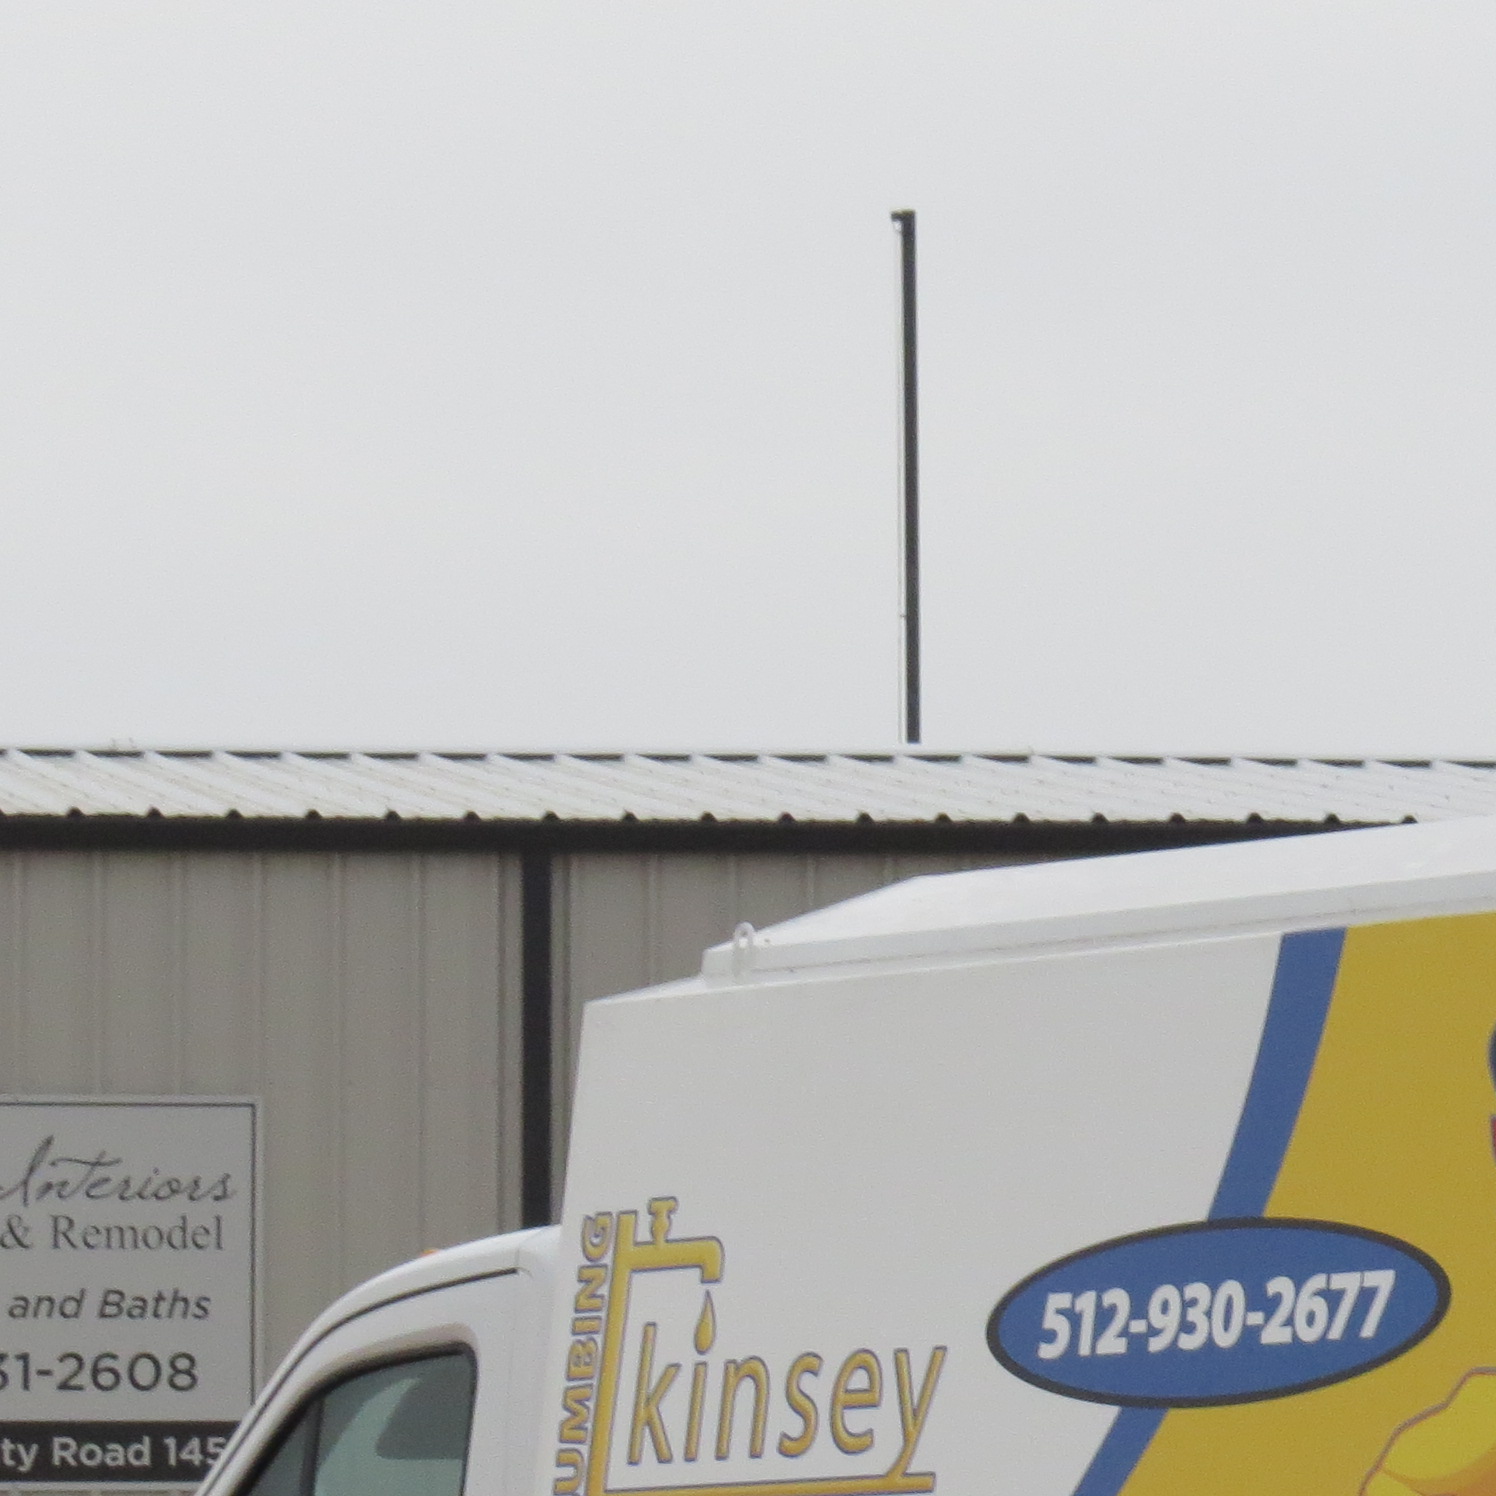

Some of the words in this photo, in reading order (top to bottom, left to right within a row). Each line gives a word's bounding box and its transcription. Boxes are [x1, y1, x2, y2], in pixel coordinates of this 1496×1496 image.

[0, 1213, 31, 1250] &
[50, 1213, 223, 1251] Remodel
[8, 1288, 86, 1320] and
[100, 1289, 210, 1321] Baths
[1037, 1269, 1396, 1361] 512-930-2677
[627, 1320, 948, 1477] kinsey
[52, 1435, 151, 1468] Road
